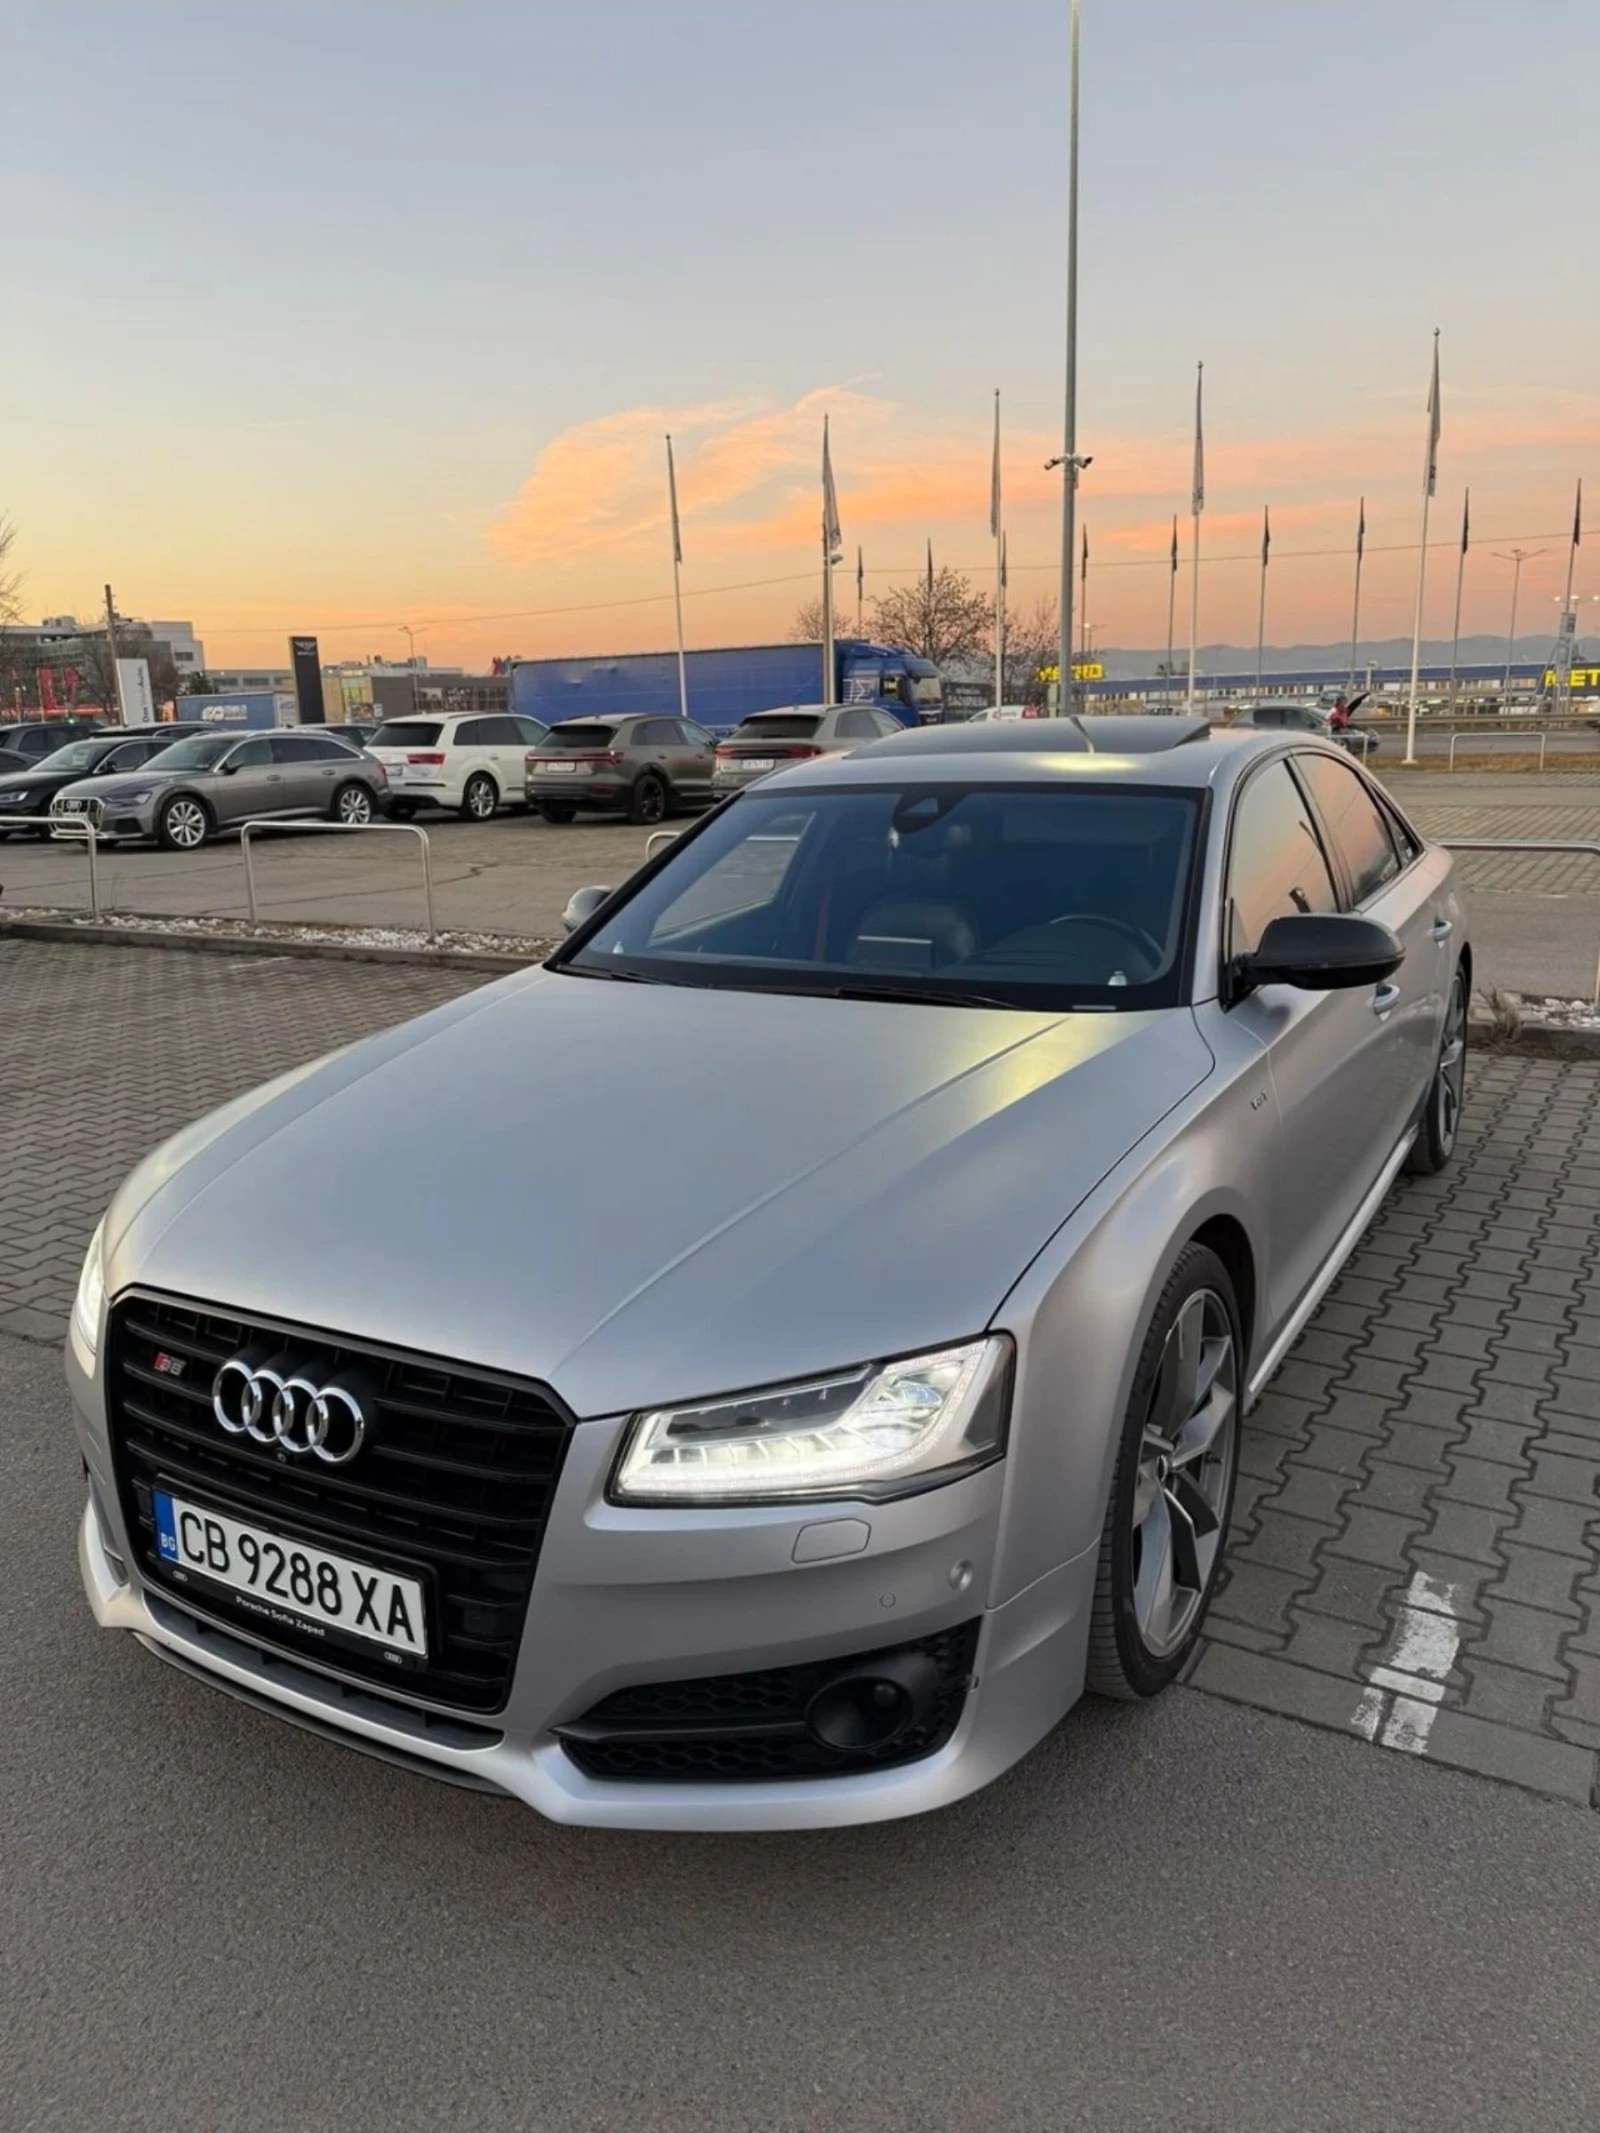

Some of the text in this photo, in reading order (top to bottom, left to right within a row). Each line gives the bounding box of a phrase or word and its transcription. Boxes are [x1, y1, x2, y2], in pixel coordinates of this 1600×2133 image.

[160, 1532, 176, 1551] BG
[179, 1511, 416, 1643] CB 9288 XA
[236, 1595, 326, 1637] Porsche Sofia Zapad
